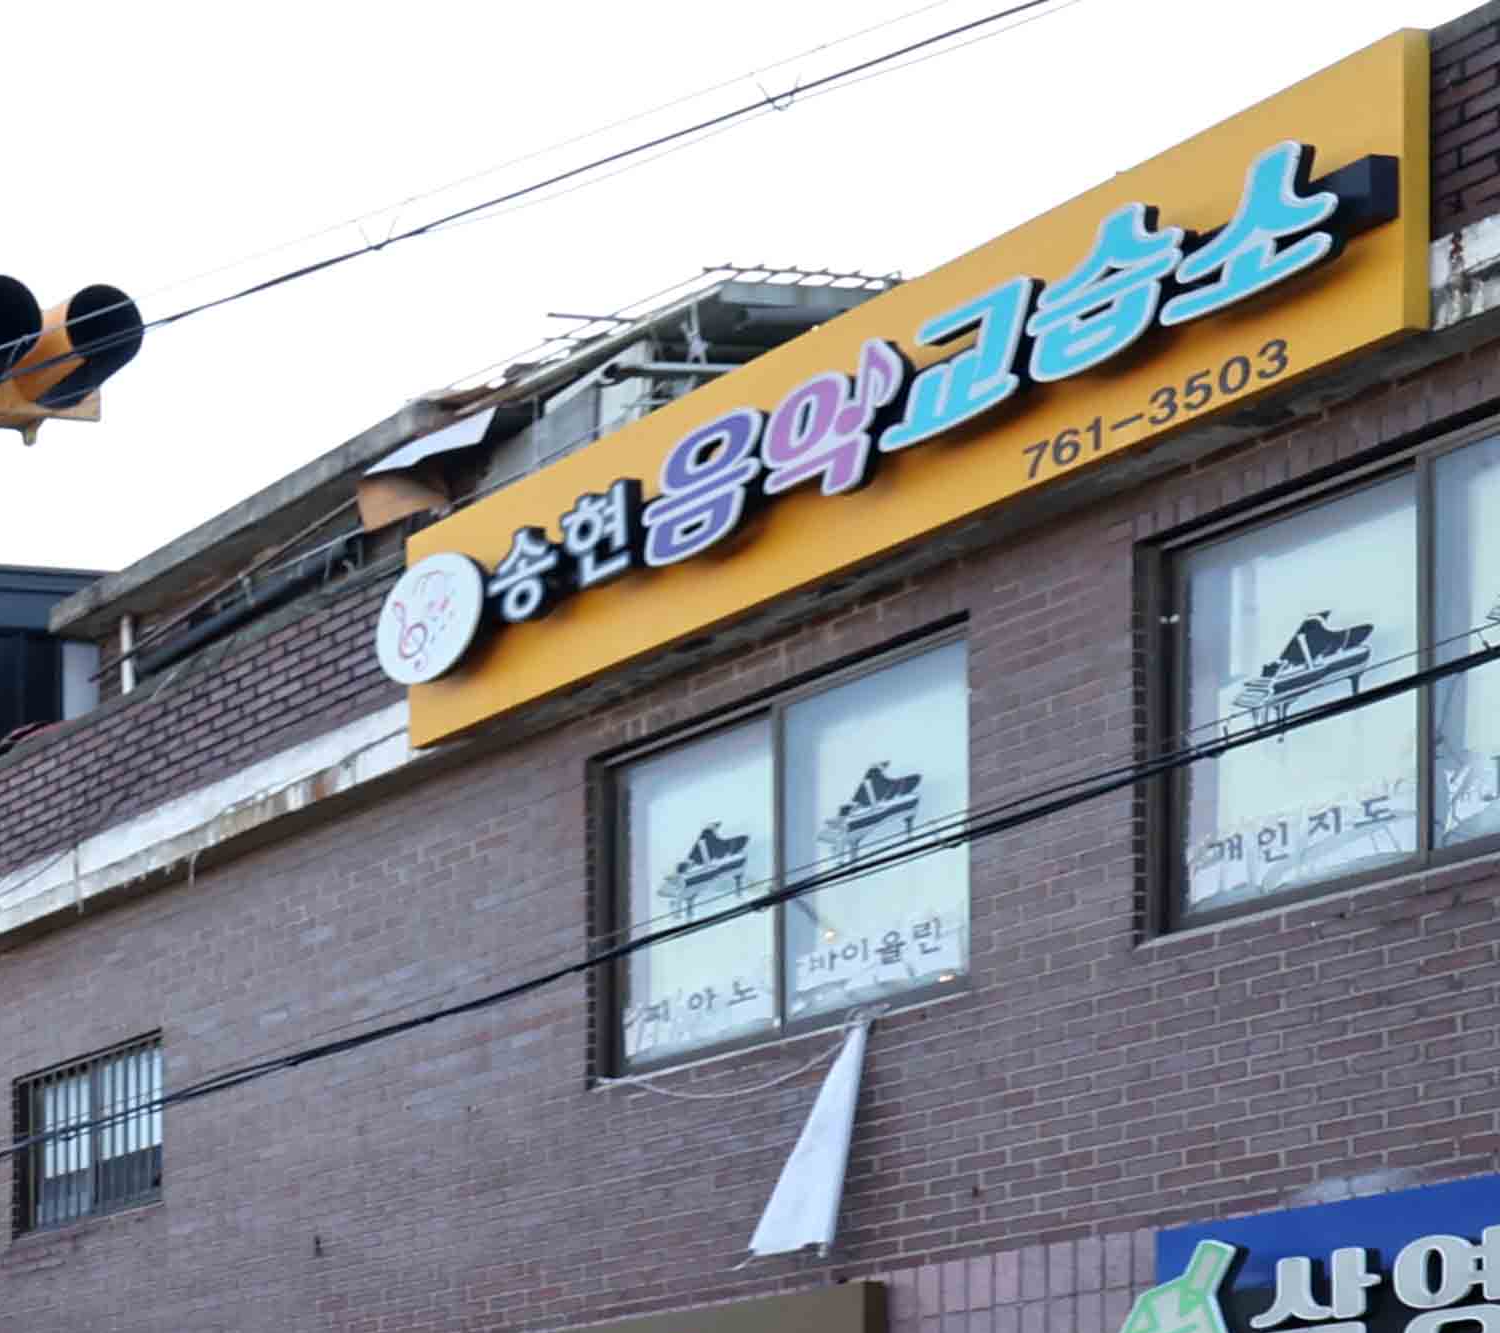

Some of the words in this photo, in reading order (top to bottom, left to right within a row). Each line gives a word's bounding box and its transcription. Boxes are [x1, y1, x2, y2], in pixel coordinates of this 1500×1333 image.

[1023, 337, 1290, 483] 761-3503
[1208, 796, 1396, 863] 개인지도
[809, 917, 942, 974] 바이올린
